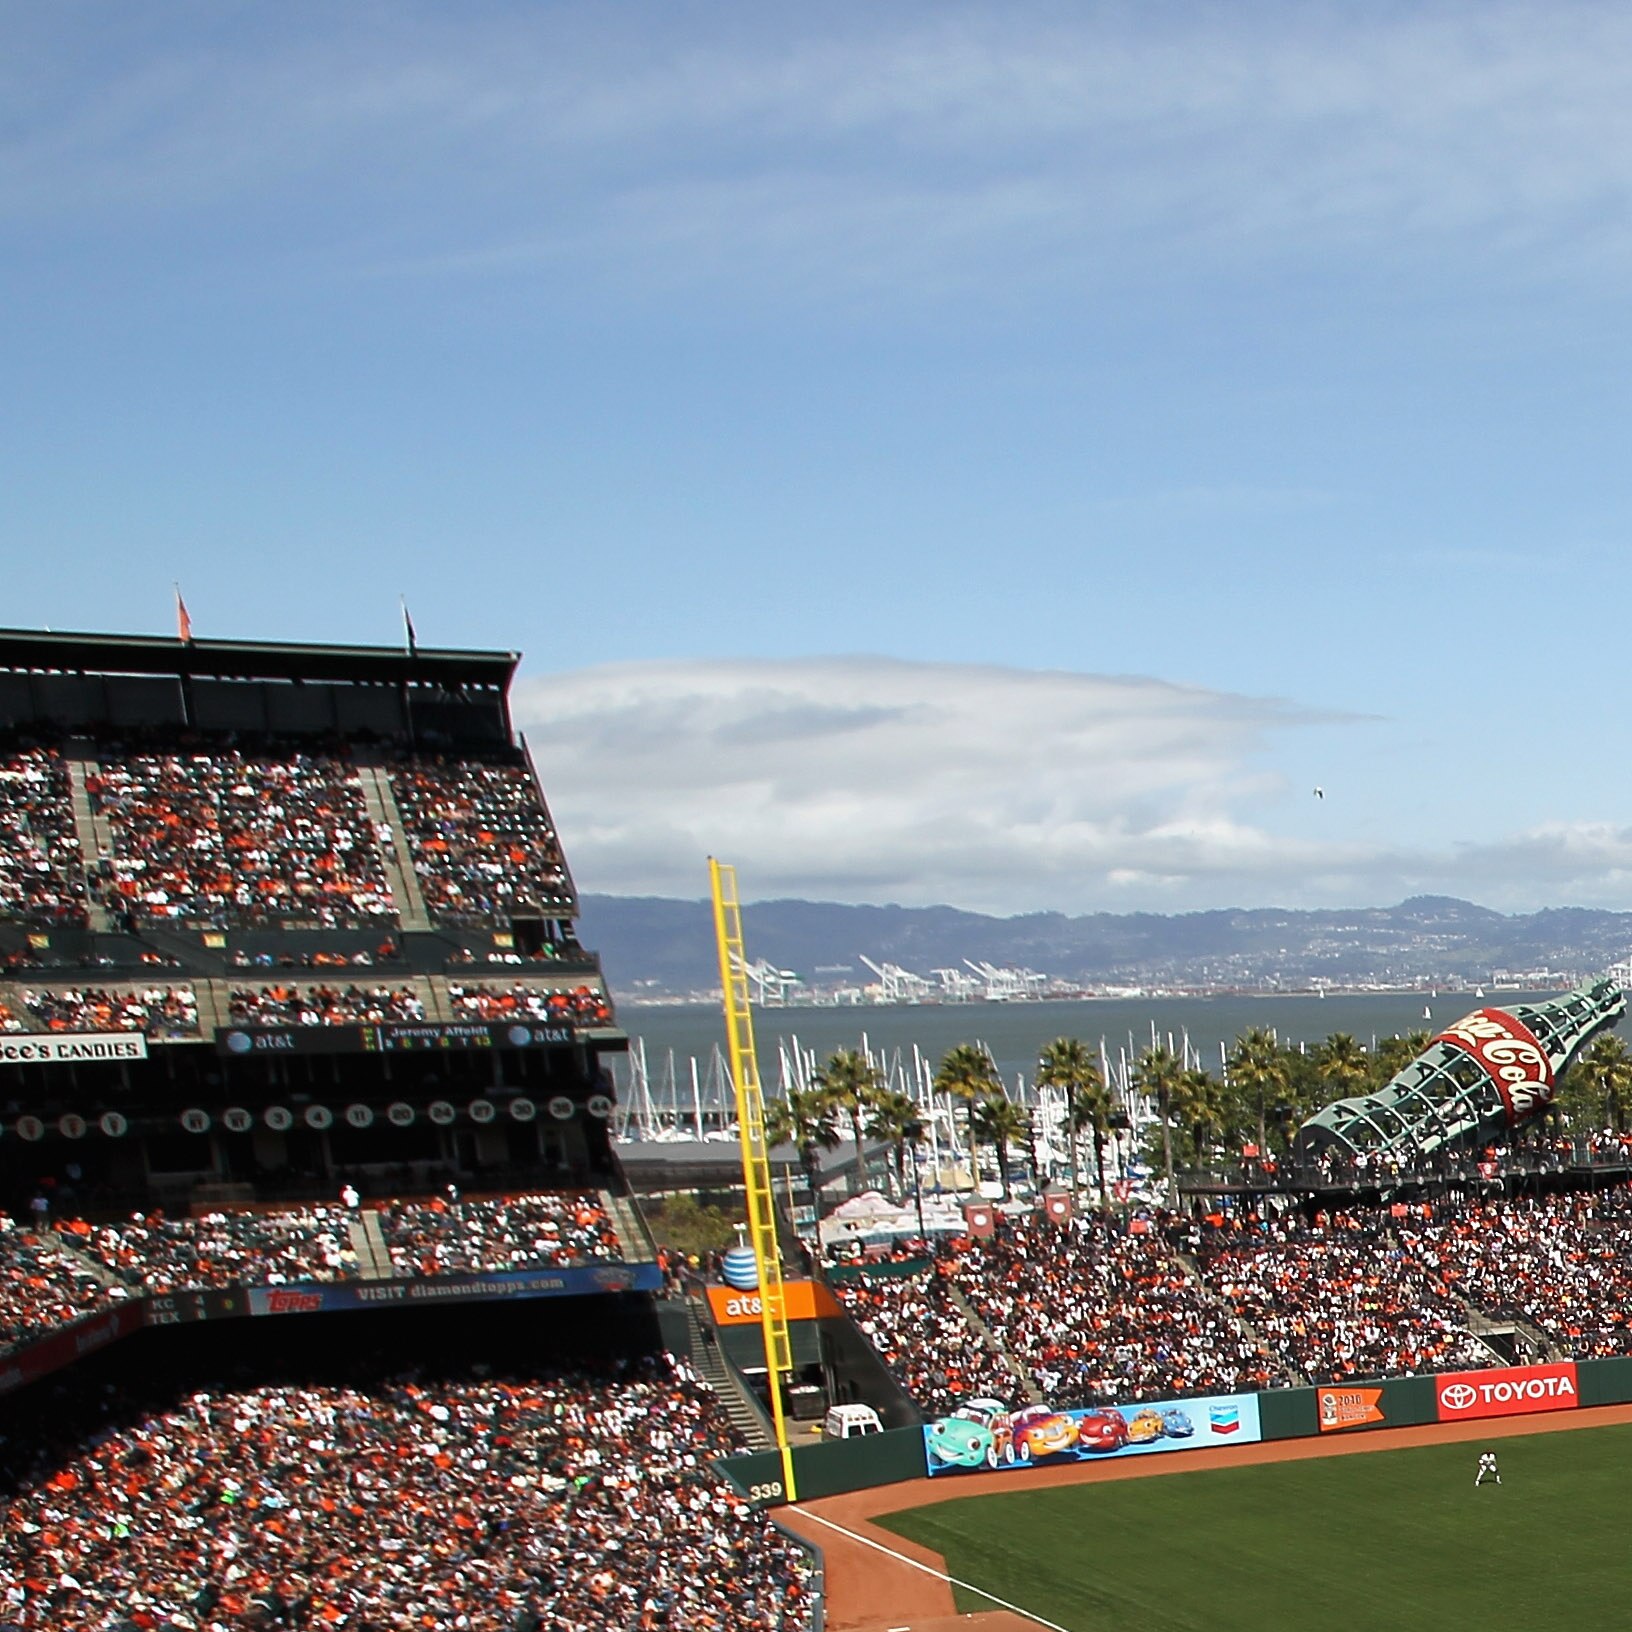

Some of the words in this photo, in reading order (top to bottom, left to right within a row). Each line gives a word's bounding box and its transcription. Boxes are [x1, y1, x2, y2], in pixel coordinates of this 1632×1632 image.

[256, 1032, 295, 1049] at&t
[533, 1029, 570, 1043] at&t
[57, 1042, 140, 1059] CANDIES
[357, 1286, 405, 1300] VISIT
[411, 1278, 566, 1299] diamondtopps.com
[151, 1299, 175, 1310] KC
[150, 1313, 180, 1325] TEX
[1480, 1376, 1575, 1404] TOYOTA
[1338, 1394, 1362, 1406] 2010
[750, 1481, 782, 1501] 339
